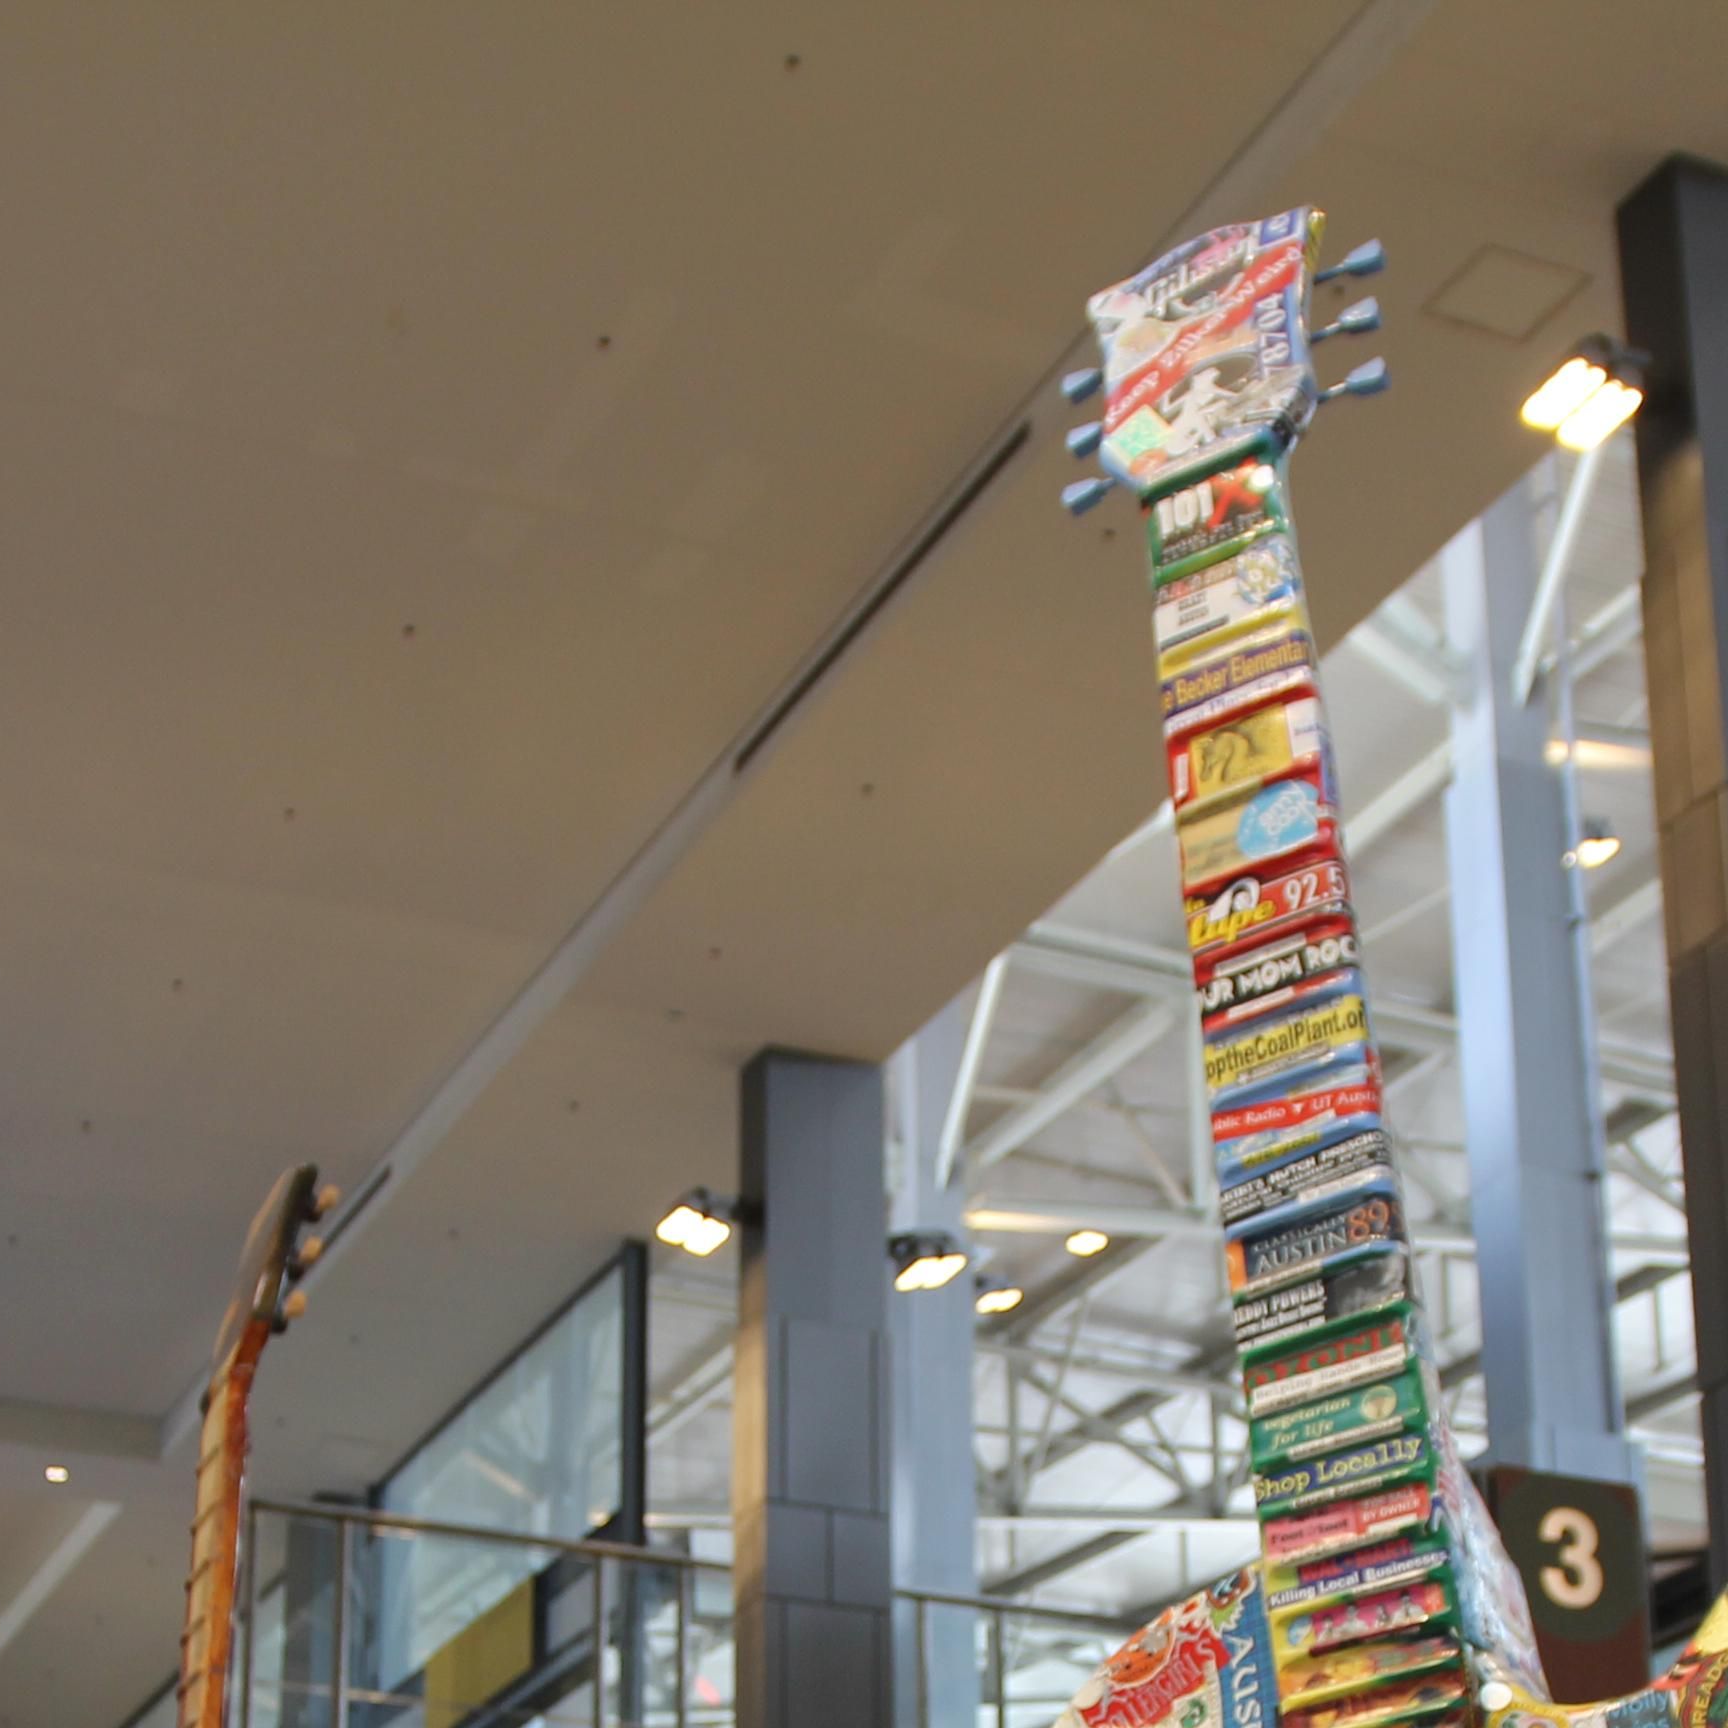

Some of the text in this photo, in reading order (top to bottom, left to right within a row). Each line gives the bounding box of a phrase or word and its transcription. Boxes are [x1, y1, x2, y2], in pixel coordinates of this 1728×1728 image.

[1283, 866, 1347, 911] 92.5
[1346, 1199, 1392, 1246] 89
[1254, 1226, 1349, 1278] AUSTIN
[1262, 1395, 1352, 1434] vegetarian
[1272, 1415, 1335, 1451] for life
[1254, 1435, 1422, 1502] Shop Locally
[1536, 1504, 1602, 1610] 3
